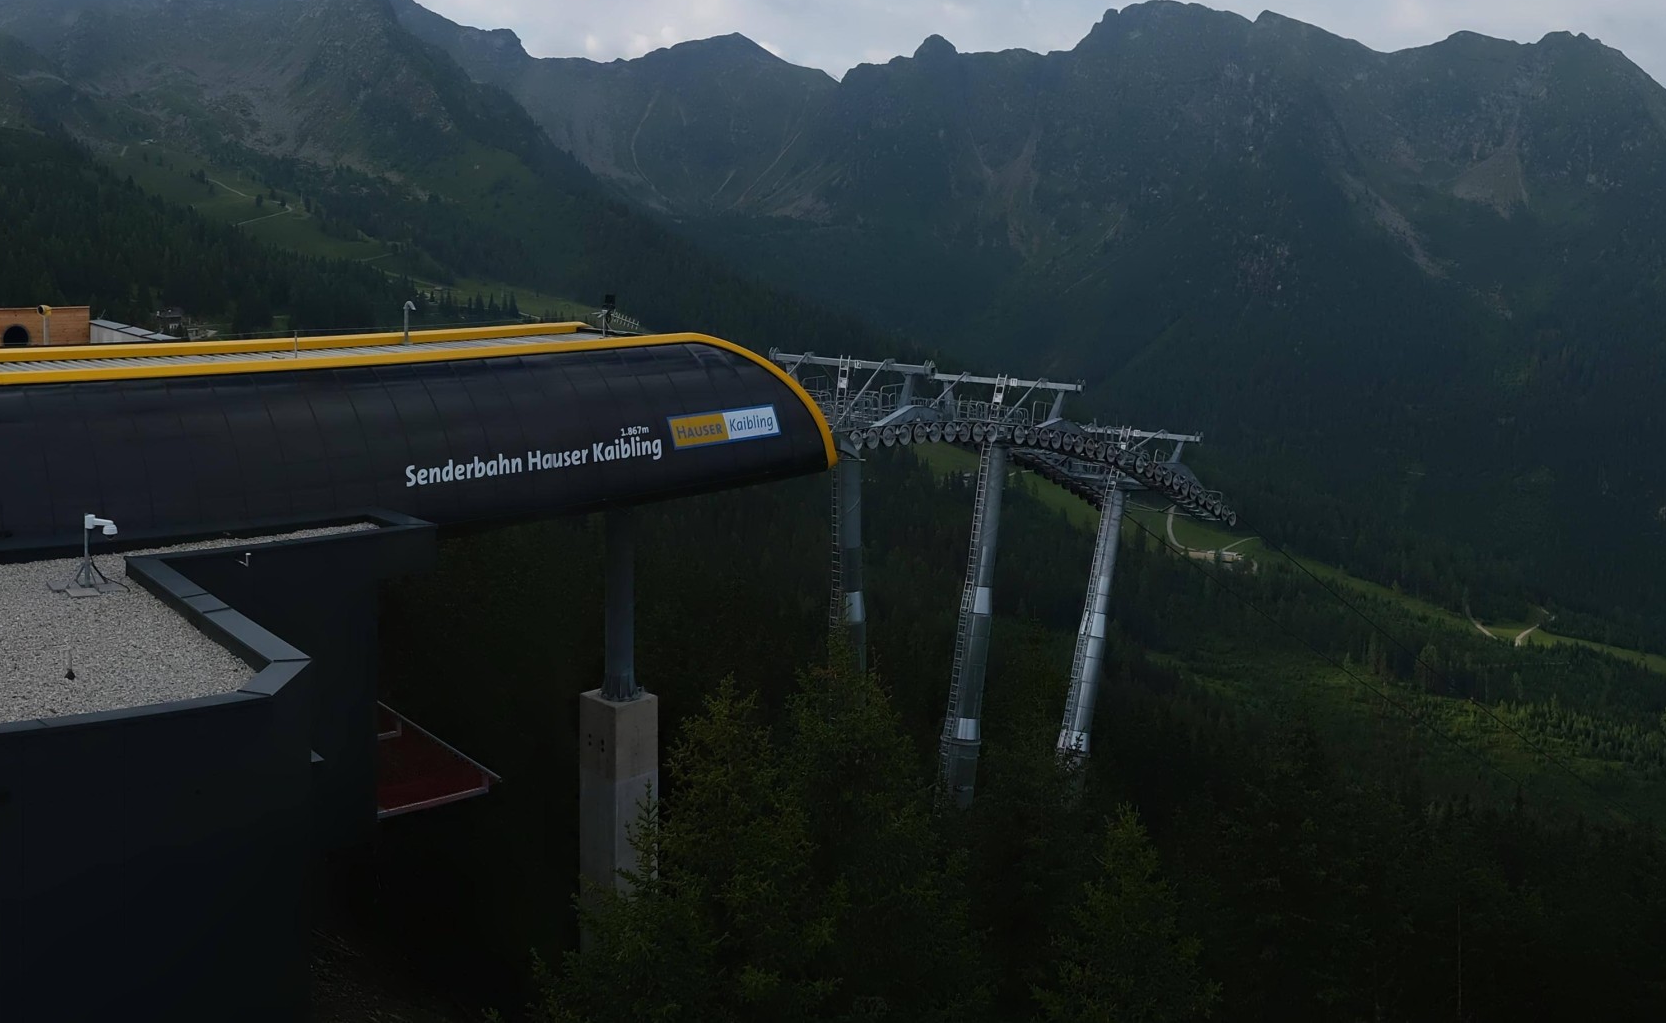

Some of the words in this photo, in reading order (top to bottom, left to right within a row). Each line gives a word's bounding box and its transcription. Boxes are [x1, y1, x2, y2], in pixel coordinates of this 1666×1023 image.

[620, 425, 649, 437] 1.867m
[676, 423, 723, 439] HAUSER
[729, 415, 773, 432] Kaibling
[405, 453, 522, 487] Senderbahn
[528, 448, 588, 471] Hauser
[592, 437, 662, 463] Kaibling
